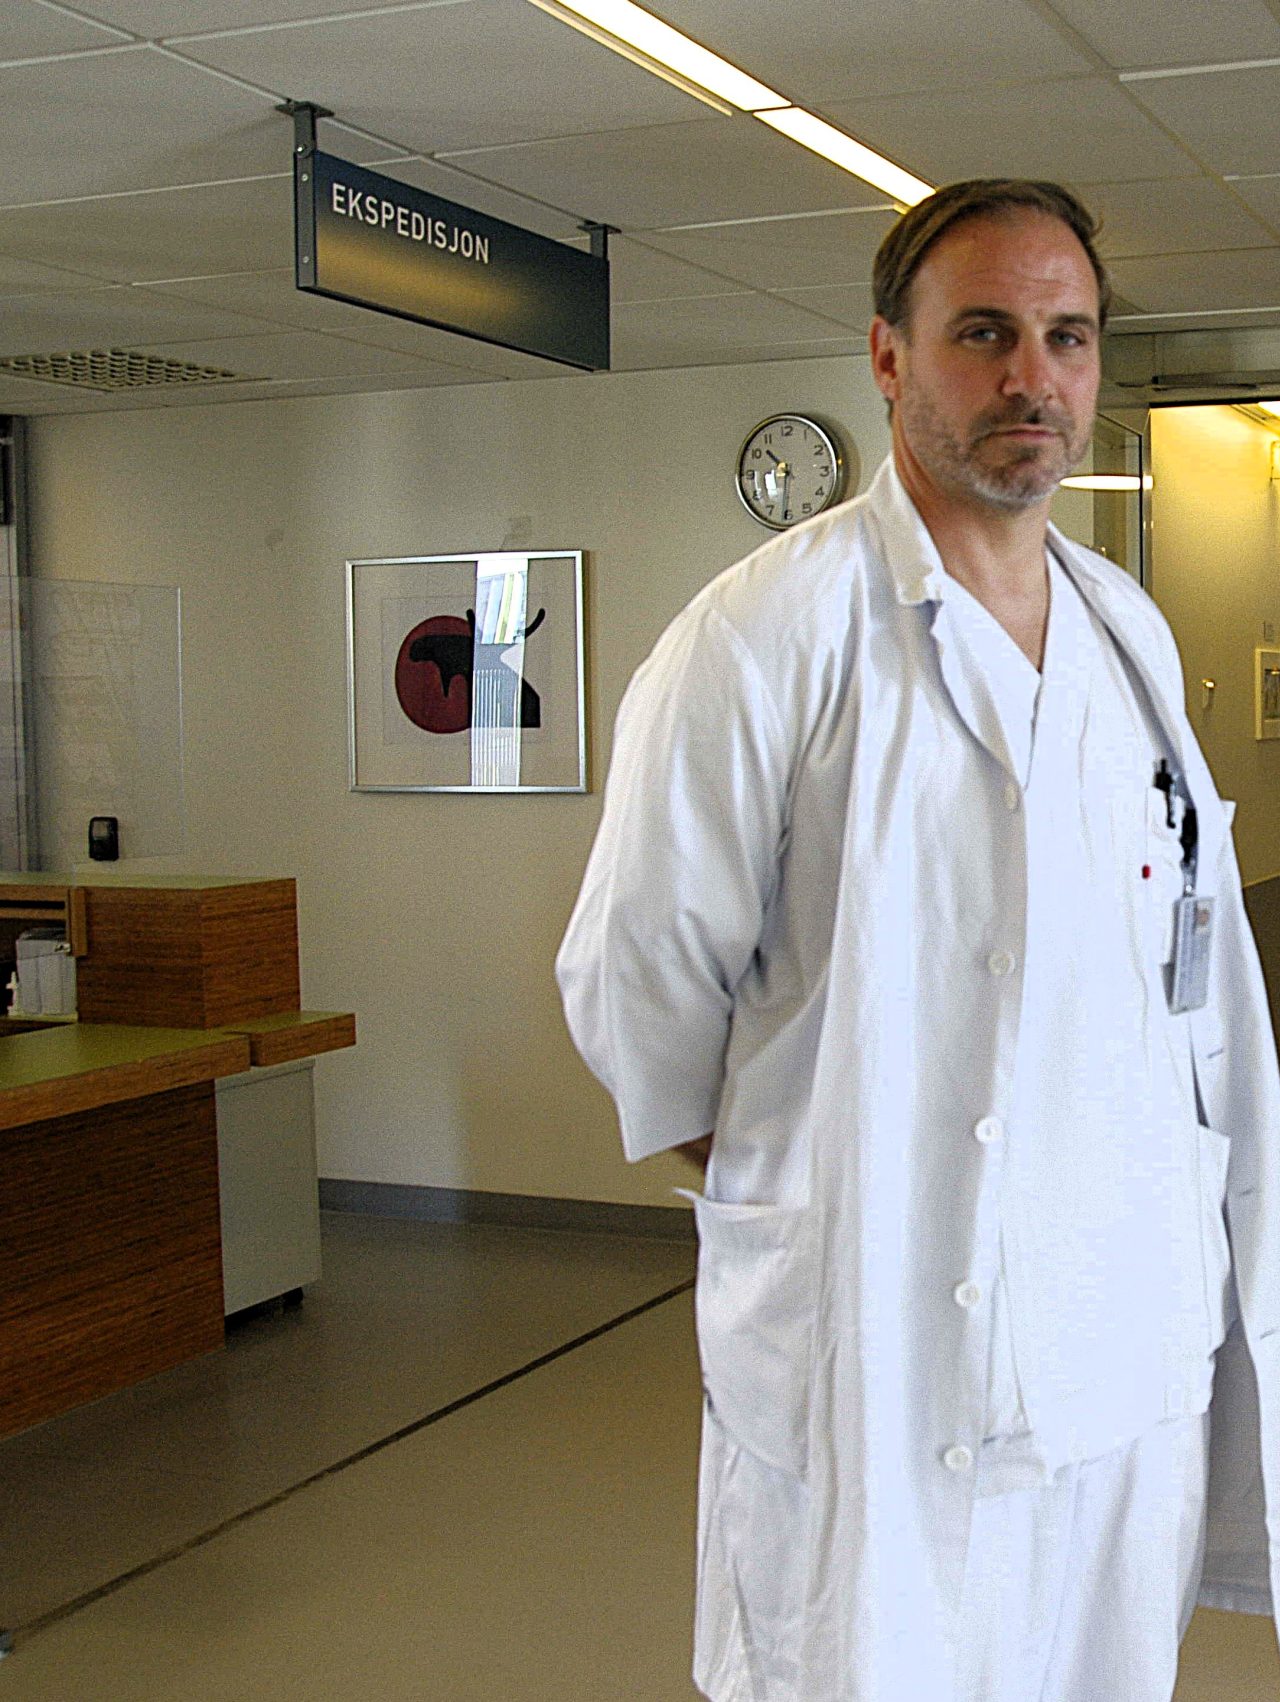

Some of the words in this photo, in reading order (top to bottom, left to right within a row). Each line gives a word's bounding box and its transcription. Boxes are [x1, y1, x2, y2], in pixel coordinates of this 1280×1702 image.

[331, 182, 490, 265] EKSPEDISJON
[781, 426, 793, 437] 12
[764, 434, 773, 445] 11
[751, 448, 762, 460] 10
[814, 445, 824, 456] 2
[746, 469, 755, 480] 9
[820, 466, 830, 477] 3
[815, 487, 825, 496] 4
[765, 505, 774, 516] 7
[802, 503, 812, 514] 5
[784, 509, 793, 520] 6
